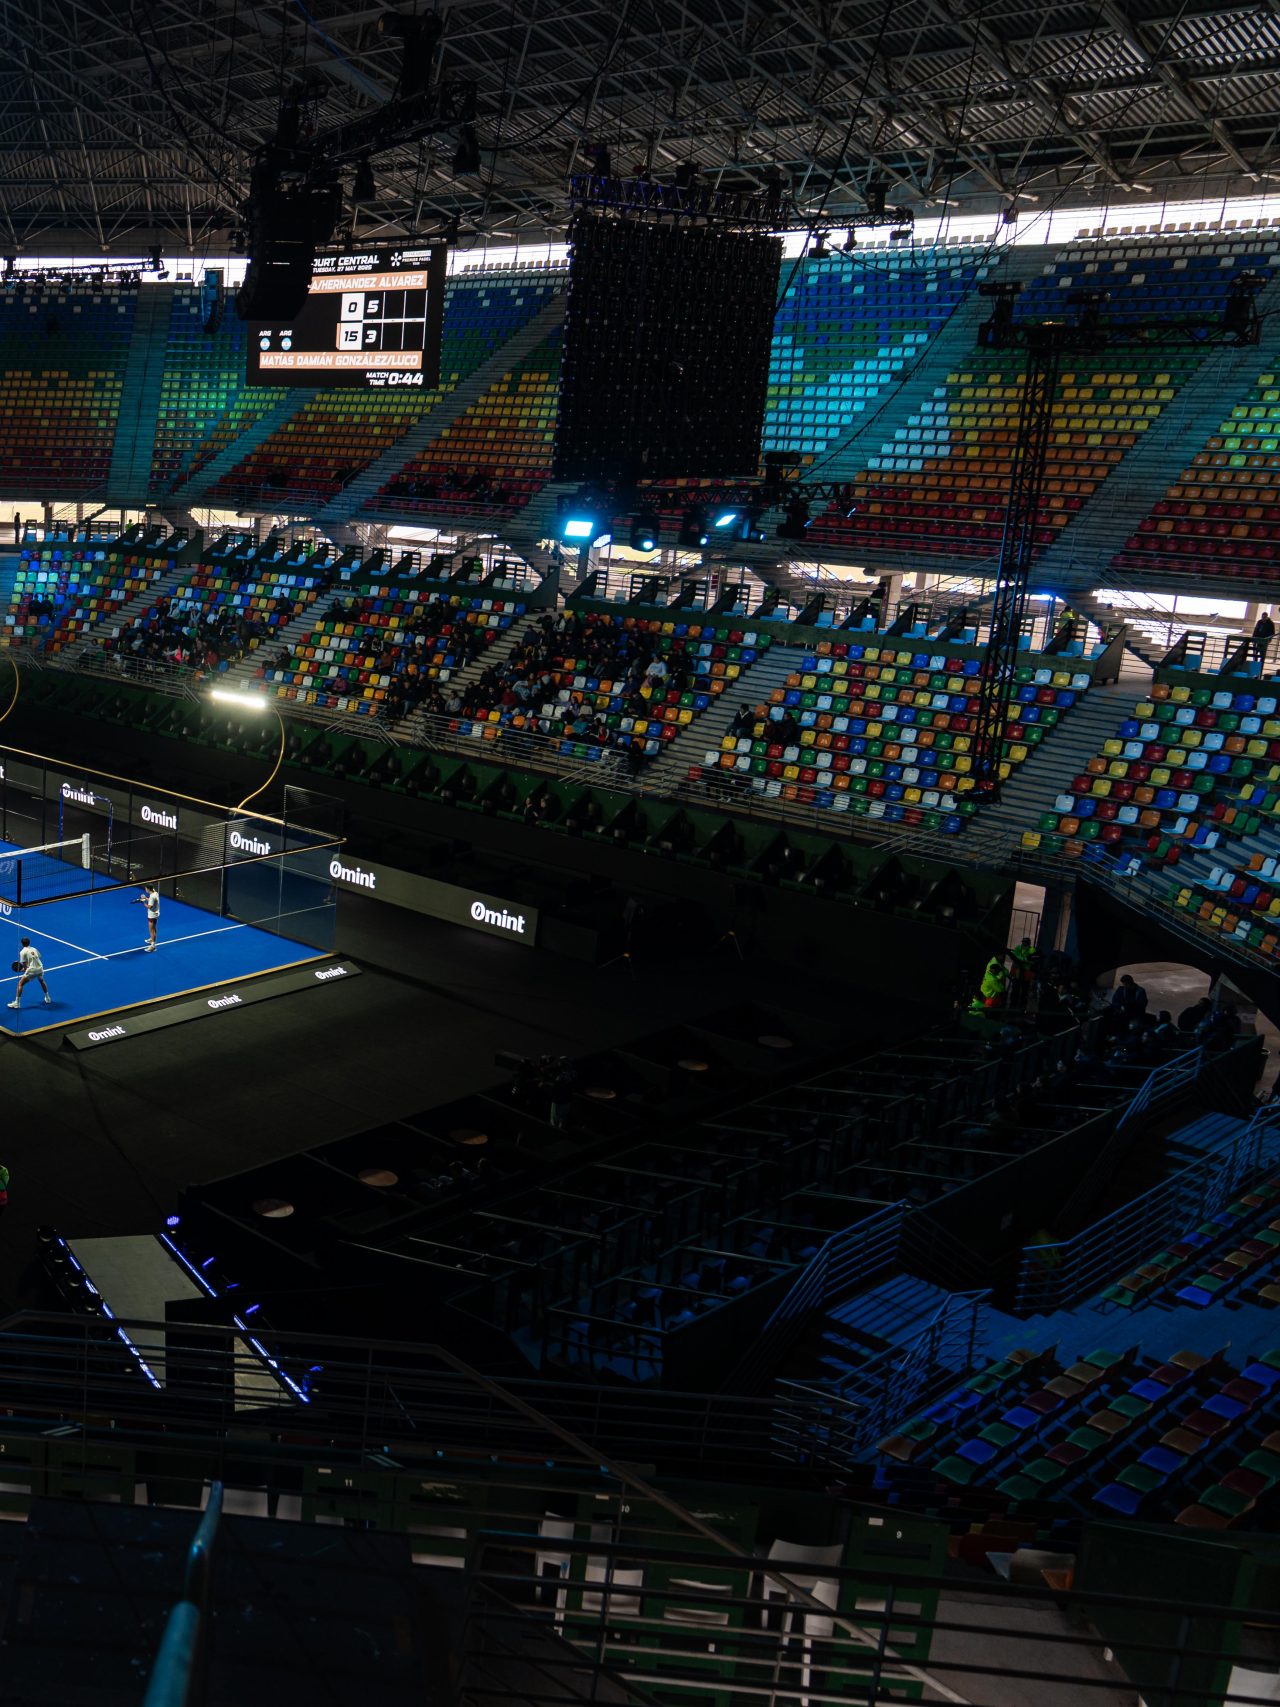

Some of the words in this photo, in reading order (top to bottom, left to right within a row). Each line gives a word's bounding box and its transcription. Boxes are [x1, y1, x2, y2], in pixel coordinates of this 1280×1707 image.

[312, 258, 336, 266] OURT
[338, 255, 380, 265] CENTRAL
[379, 274, 424, 288] ALVAREZ
[348, 302, 358, 312] 0
[367, 300, 379, 313] 5
[344, 331, 358, 341] 15
[365, 330, 377, 343] 3
[261, 352, 294, 366] MATÍAS
[297, 352, 333, 366] DAMIÁN
[335, 352, 418, 366] GONZÁLEZ/LUCO
[388, 372, 423, 385] 0:44
[344, 1478, 353, 1487] 11
[621, 1504, 630, 1513] 10
